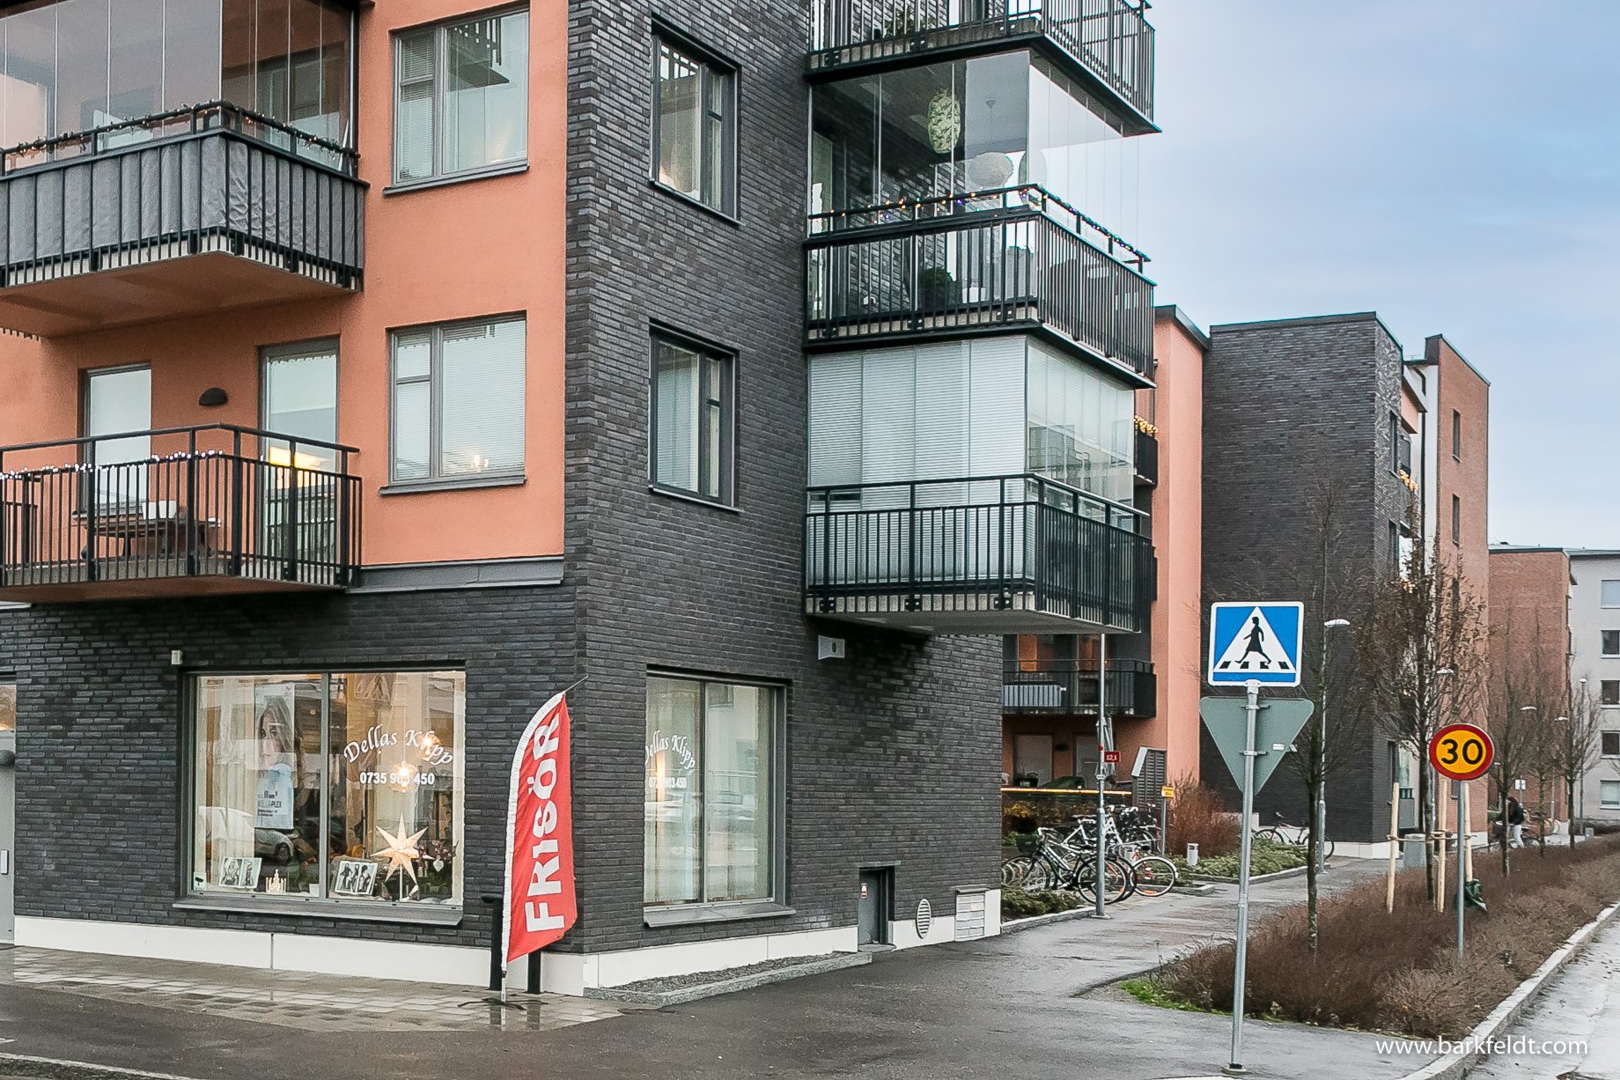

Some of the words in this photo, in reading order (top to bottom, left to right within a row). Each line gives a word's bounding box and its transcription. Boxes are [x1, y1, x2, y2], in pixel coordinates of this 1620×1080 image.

[343, 723, 398, 763] Dellas
[671, 734, 696, 770] Klipp
[1440, 738, 1483, 765] 30
[360, 772, 388, 785] 0735
[414, 772, 436, 785] 450
[649, 776, 663, 788] 07
[524, 712, 566, 934] FRISÖR
